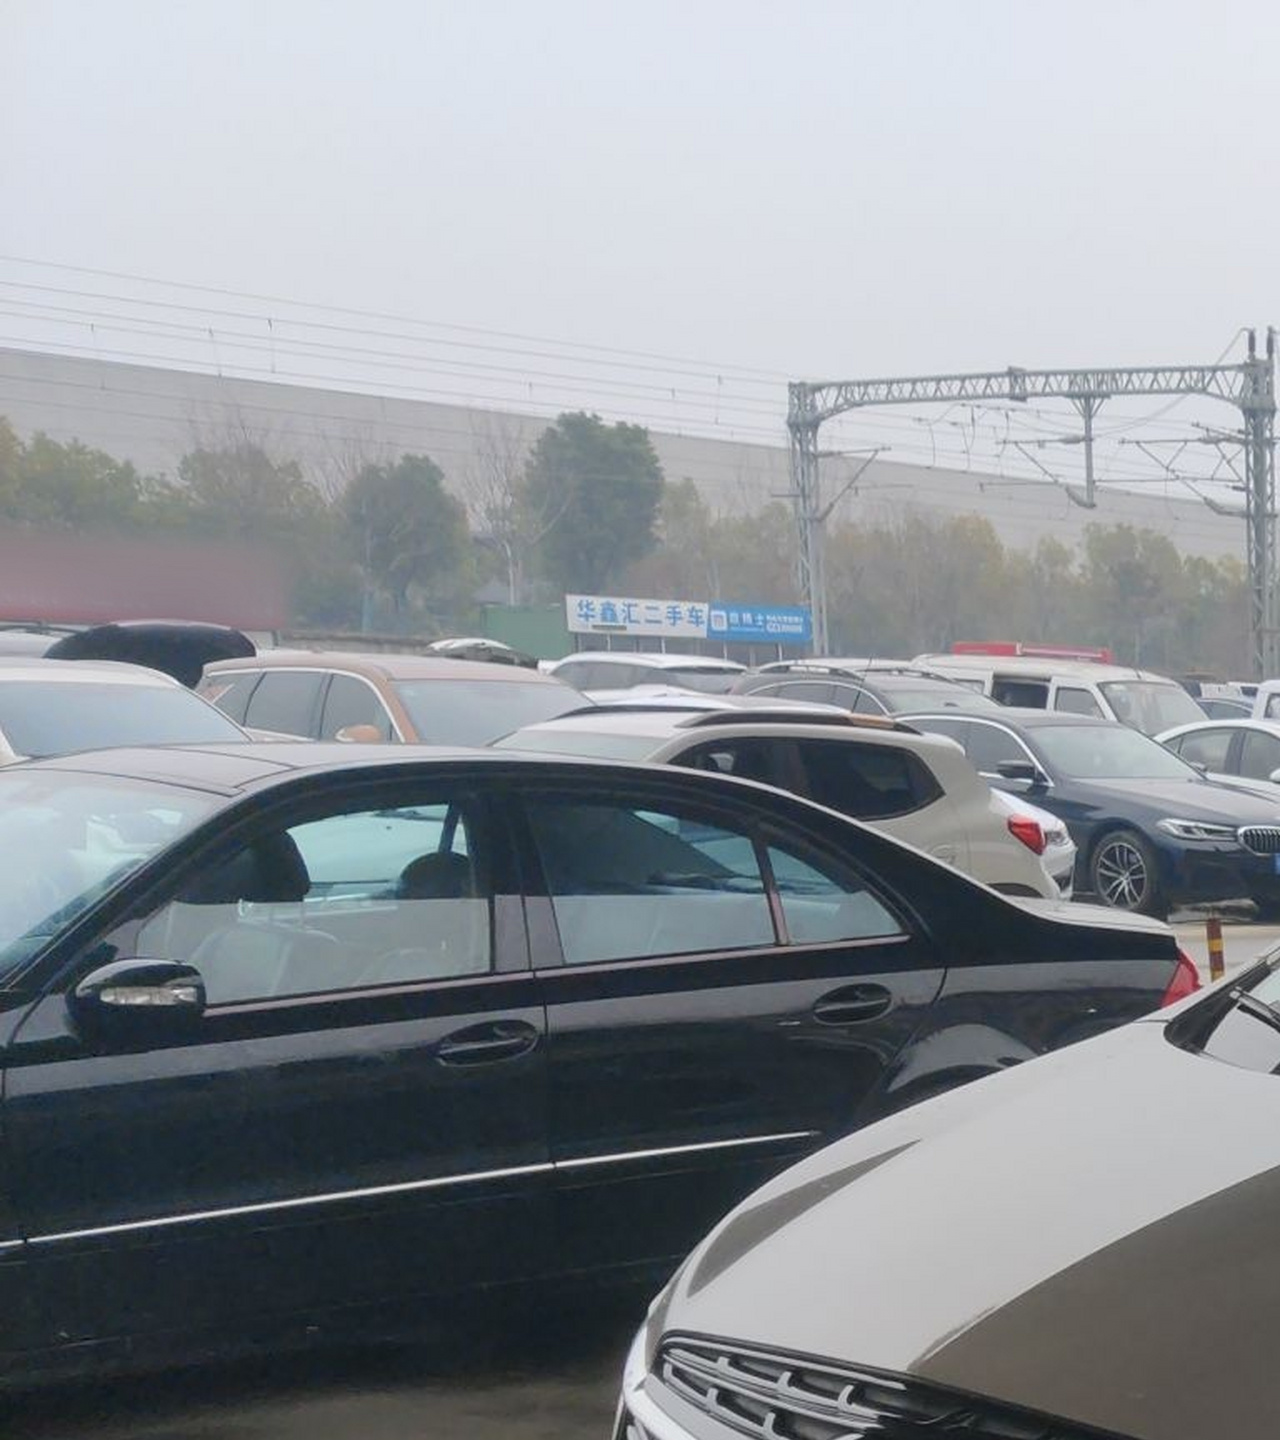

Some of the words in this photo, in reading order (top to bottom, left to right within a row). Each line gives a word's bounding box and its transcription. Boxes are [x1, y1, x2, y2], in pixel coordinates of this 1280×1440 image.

[577, 599, 706, 628] 华鑫汇二手车
